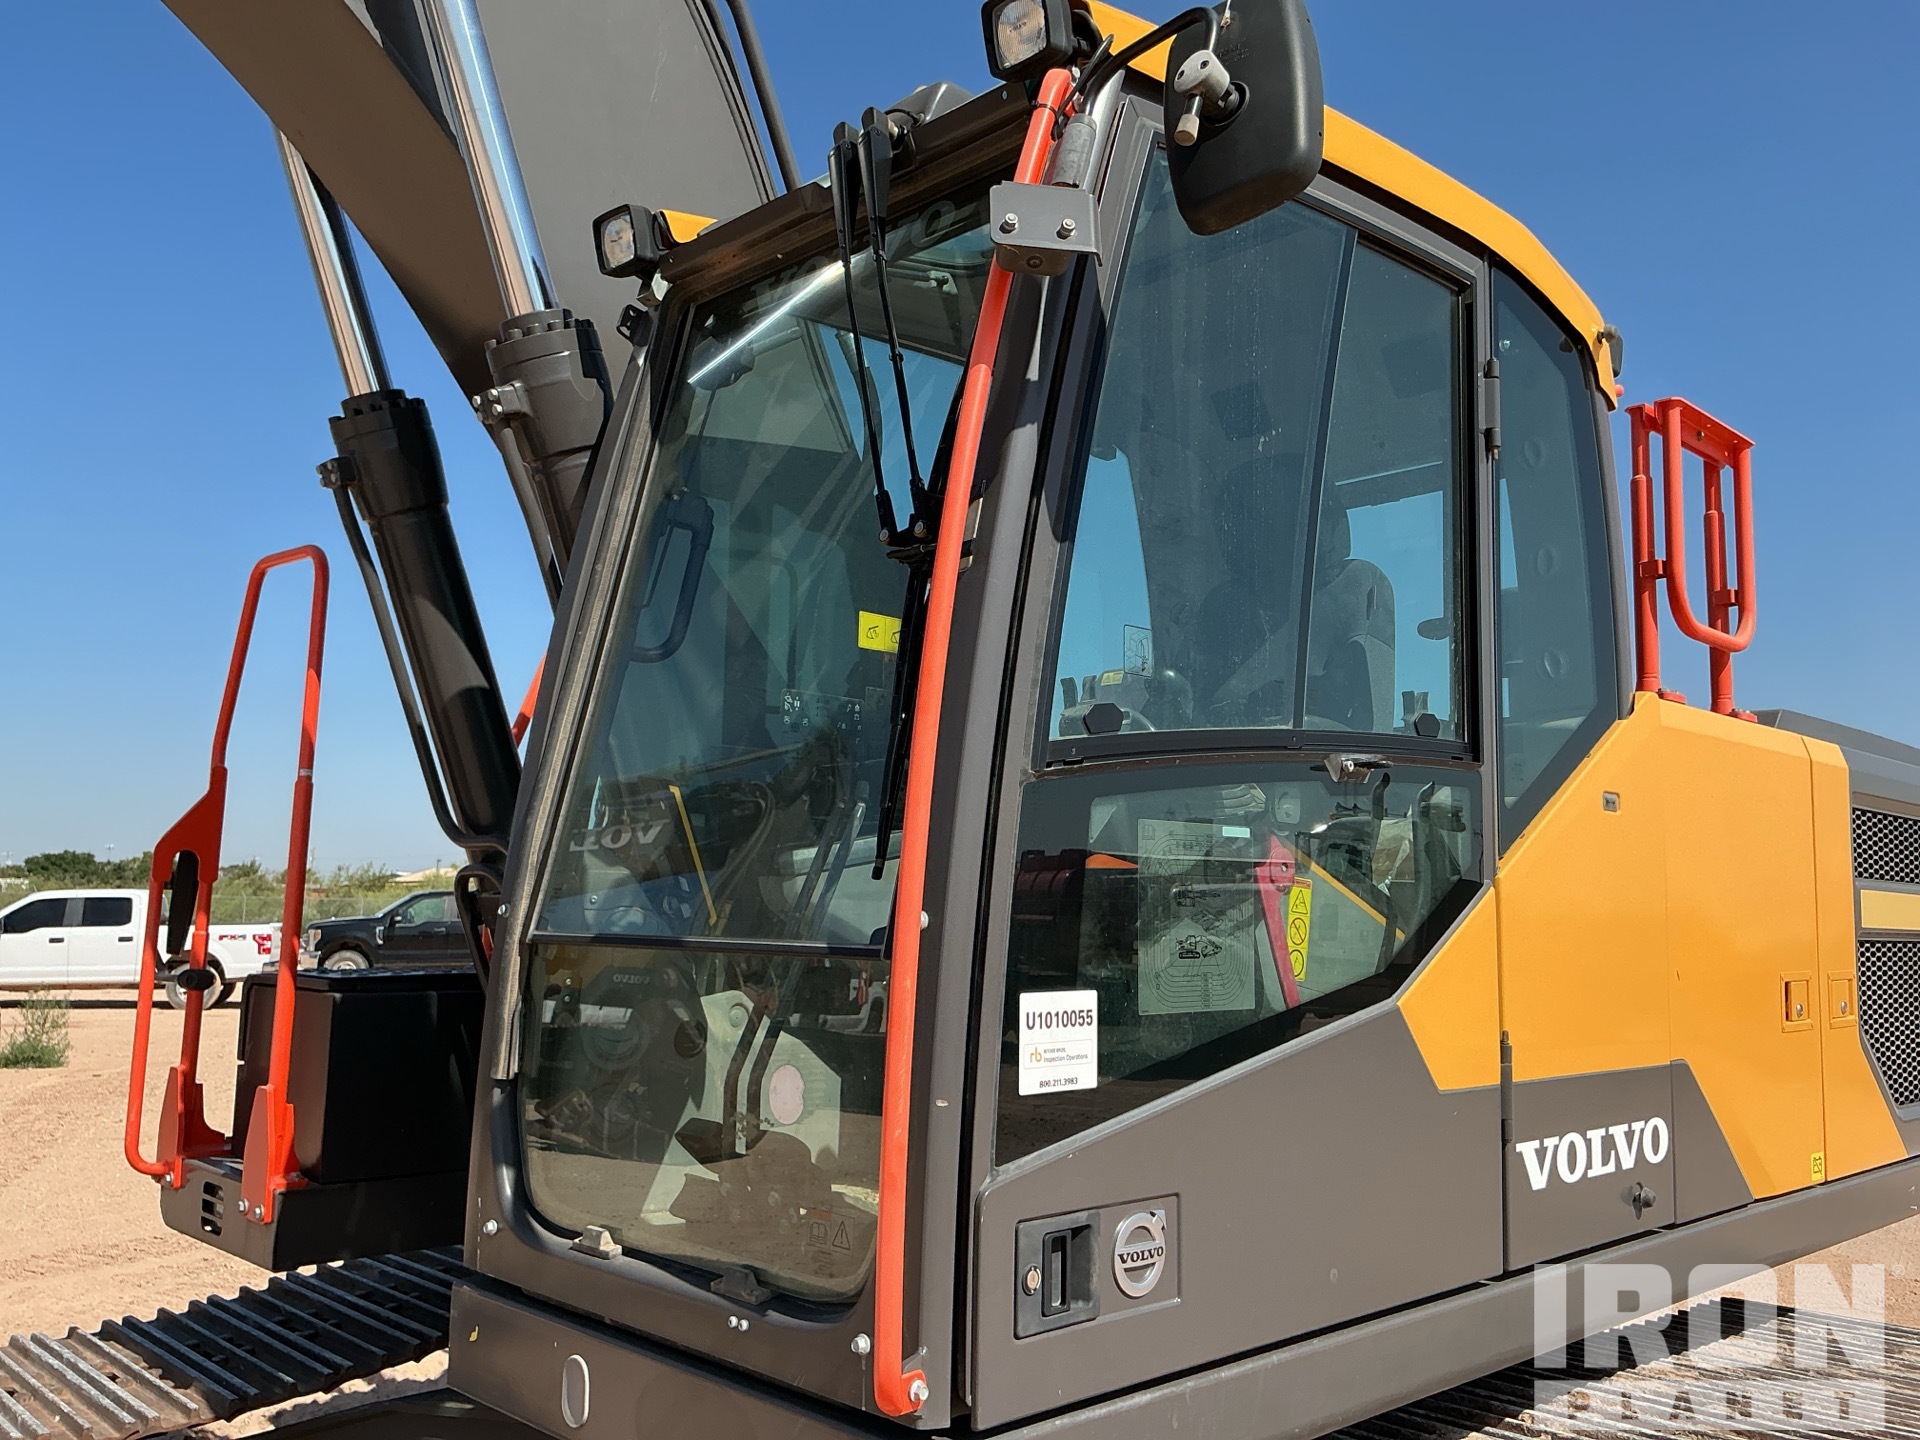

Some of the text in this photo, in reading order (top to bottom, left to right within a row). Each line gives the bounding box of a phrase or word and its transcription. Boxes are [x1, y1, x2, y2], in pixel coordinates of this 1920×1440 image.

[1026, 1009, 1093, 1030] U1010055
[1066, 1054, 1088, 1062] Operations
[1039, 1077, 1078, 1088] 800.211.3983
[1515, 1116, 1669, 1191] VOLVO
[1118, 1245, 1164, 1264] VOLVO
